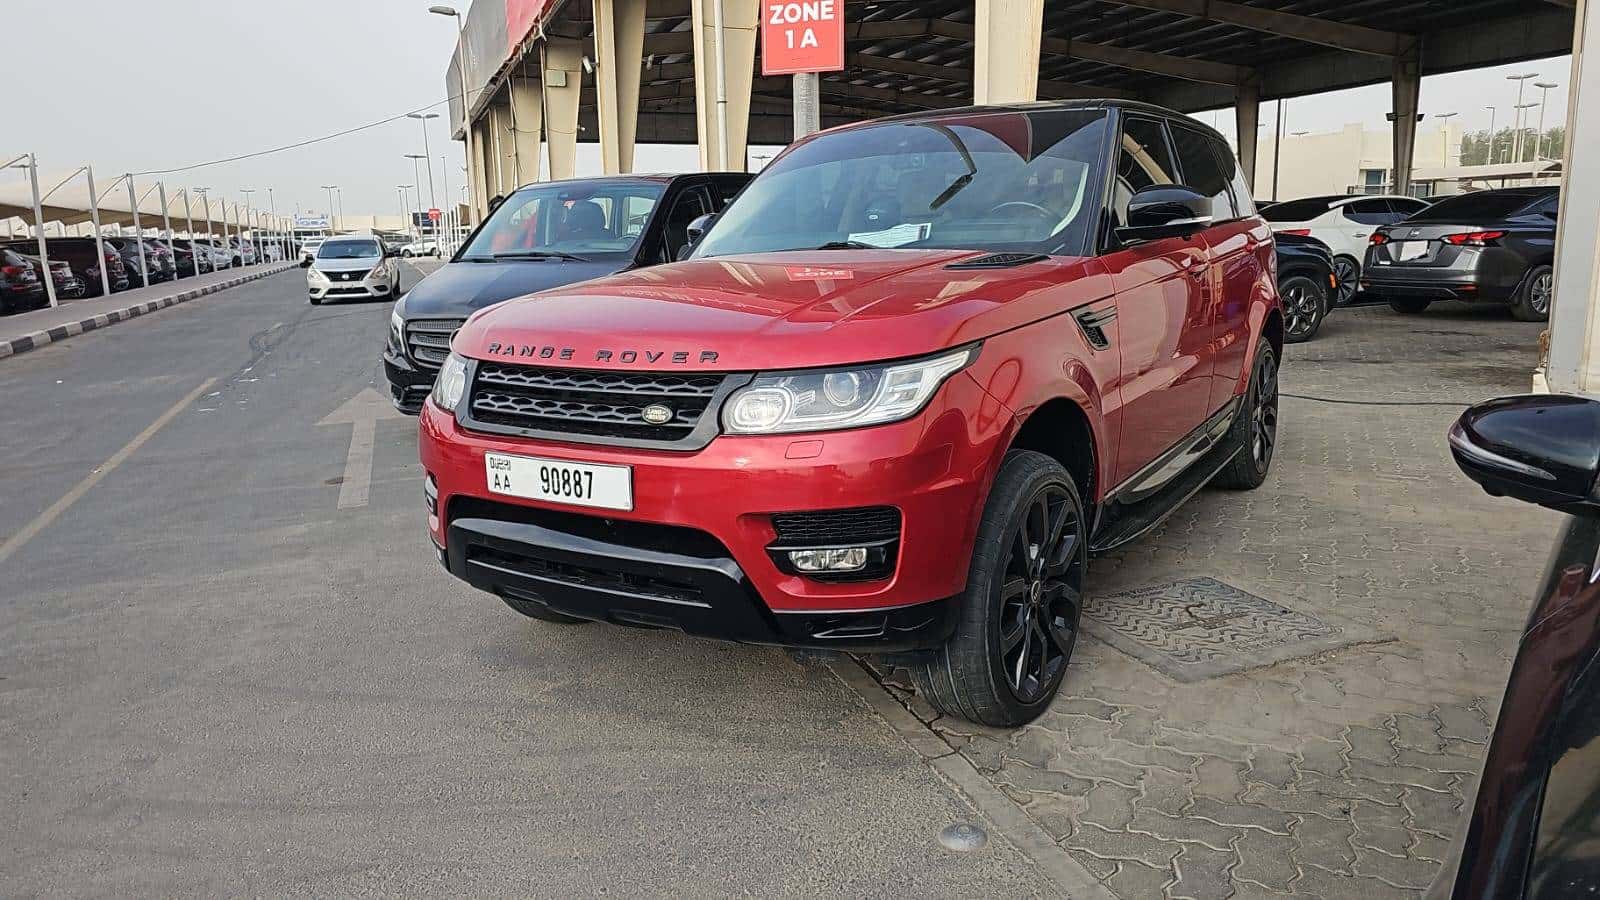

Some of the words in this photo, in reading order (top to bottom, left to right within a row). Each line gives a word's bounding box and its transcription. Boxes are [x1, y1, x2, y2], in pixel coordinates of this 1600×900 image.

[769, 0, 835, 25] ZONE
[488, 343, 575, 361] RANGE
[595, 349, 720, 365] ROVER
[540, 465, 593, 500] 90887
